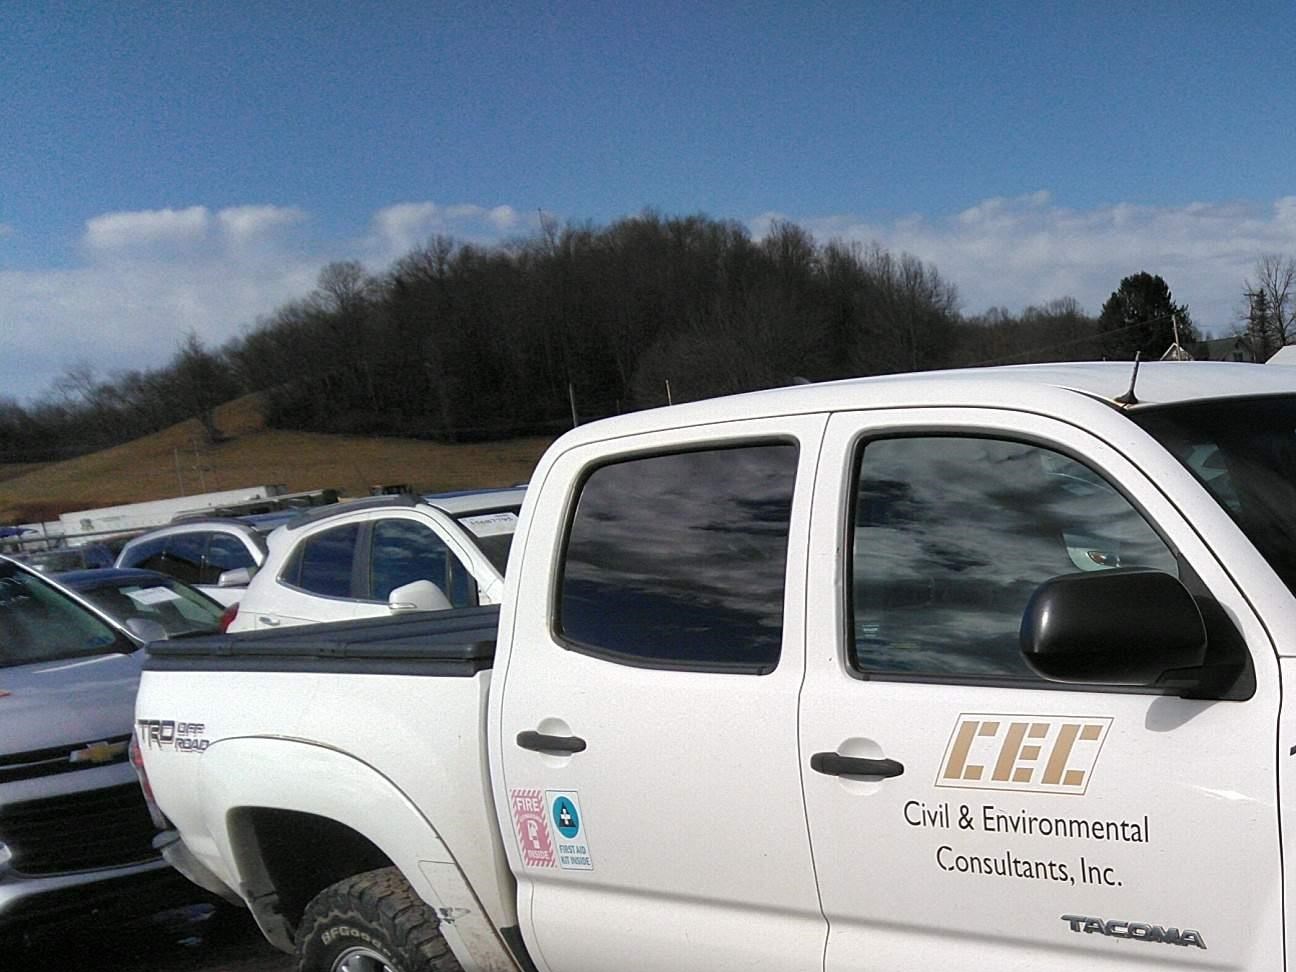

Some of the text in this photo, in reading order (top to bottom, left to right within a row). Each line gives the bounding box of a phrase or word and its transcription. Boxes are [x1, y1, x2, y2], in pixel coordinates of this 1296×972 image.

[137, 719, 176, 751] TRD
[177, 722, 205, 736] OFF
[175, 738, 209, 754] ROAD
[943, 720, 1104, 786] CEC
[516, 797, 542, 813] FIRE
[903, 800, 1149, 843] Civil & Environmental
[559, 844, 575, 854] FIRST
[936, 845, 1124, 888] Consultants, Inc.
[1060, 914, 1208, 950] TACOMA
